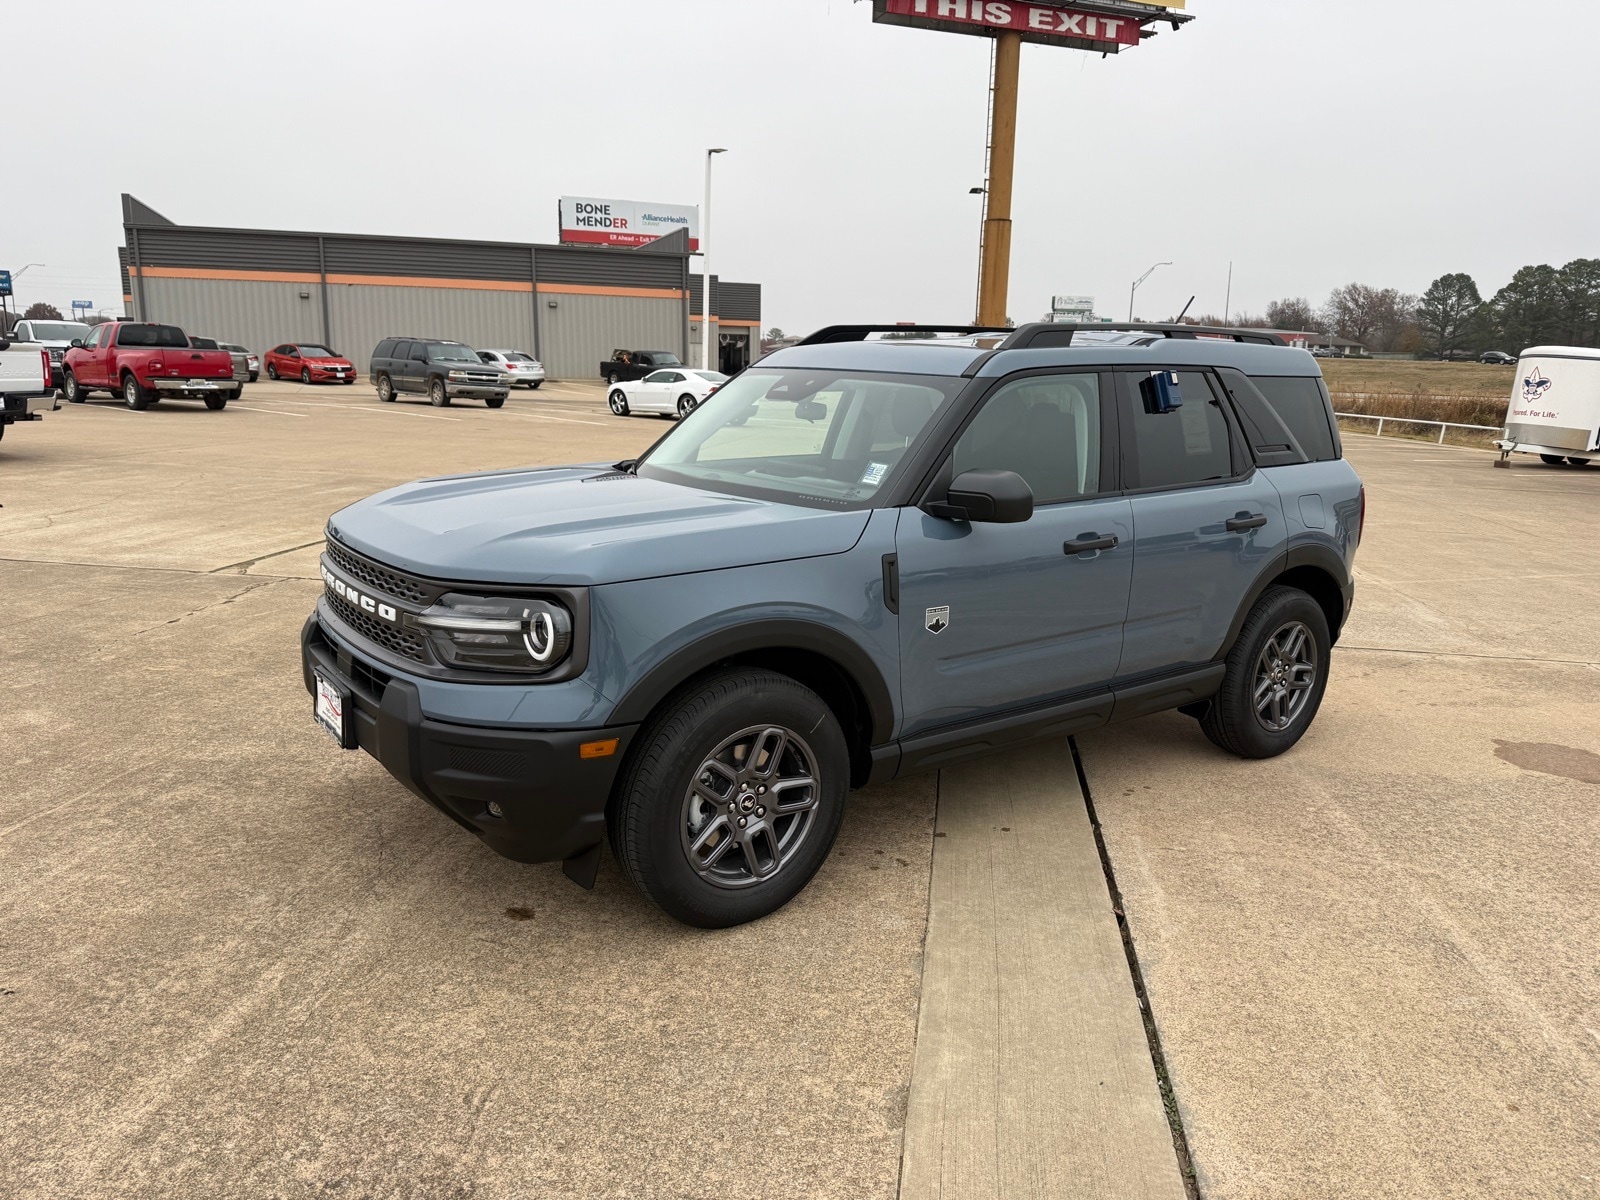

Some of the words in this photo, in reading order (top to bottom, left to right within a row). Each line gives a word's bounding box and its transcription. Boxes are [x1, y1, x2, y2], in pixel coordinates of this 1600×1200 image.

[1028, 8, 1124, 38] EXIT
[575, 202, 611, 215] BONE
[575, 215, 628, 229] MENDER
[642, 213, 688, 224] AllianceHealth
[1529, 410, 1541, 418] For
[1542, 411, 1558, 419] Life.
[320, 564, 397, 622] BRONCO
